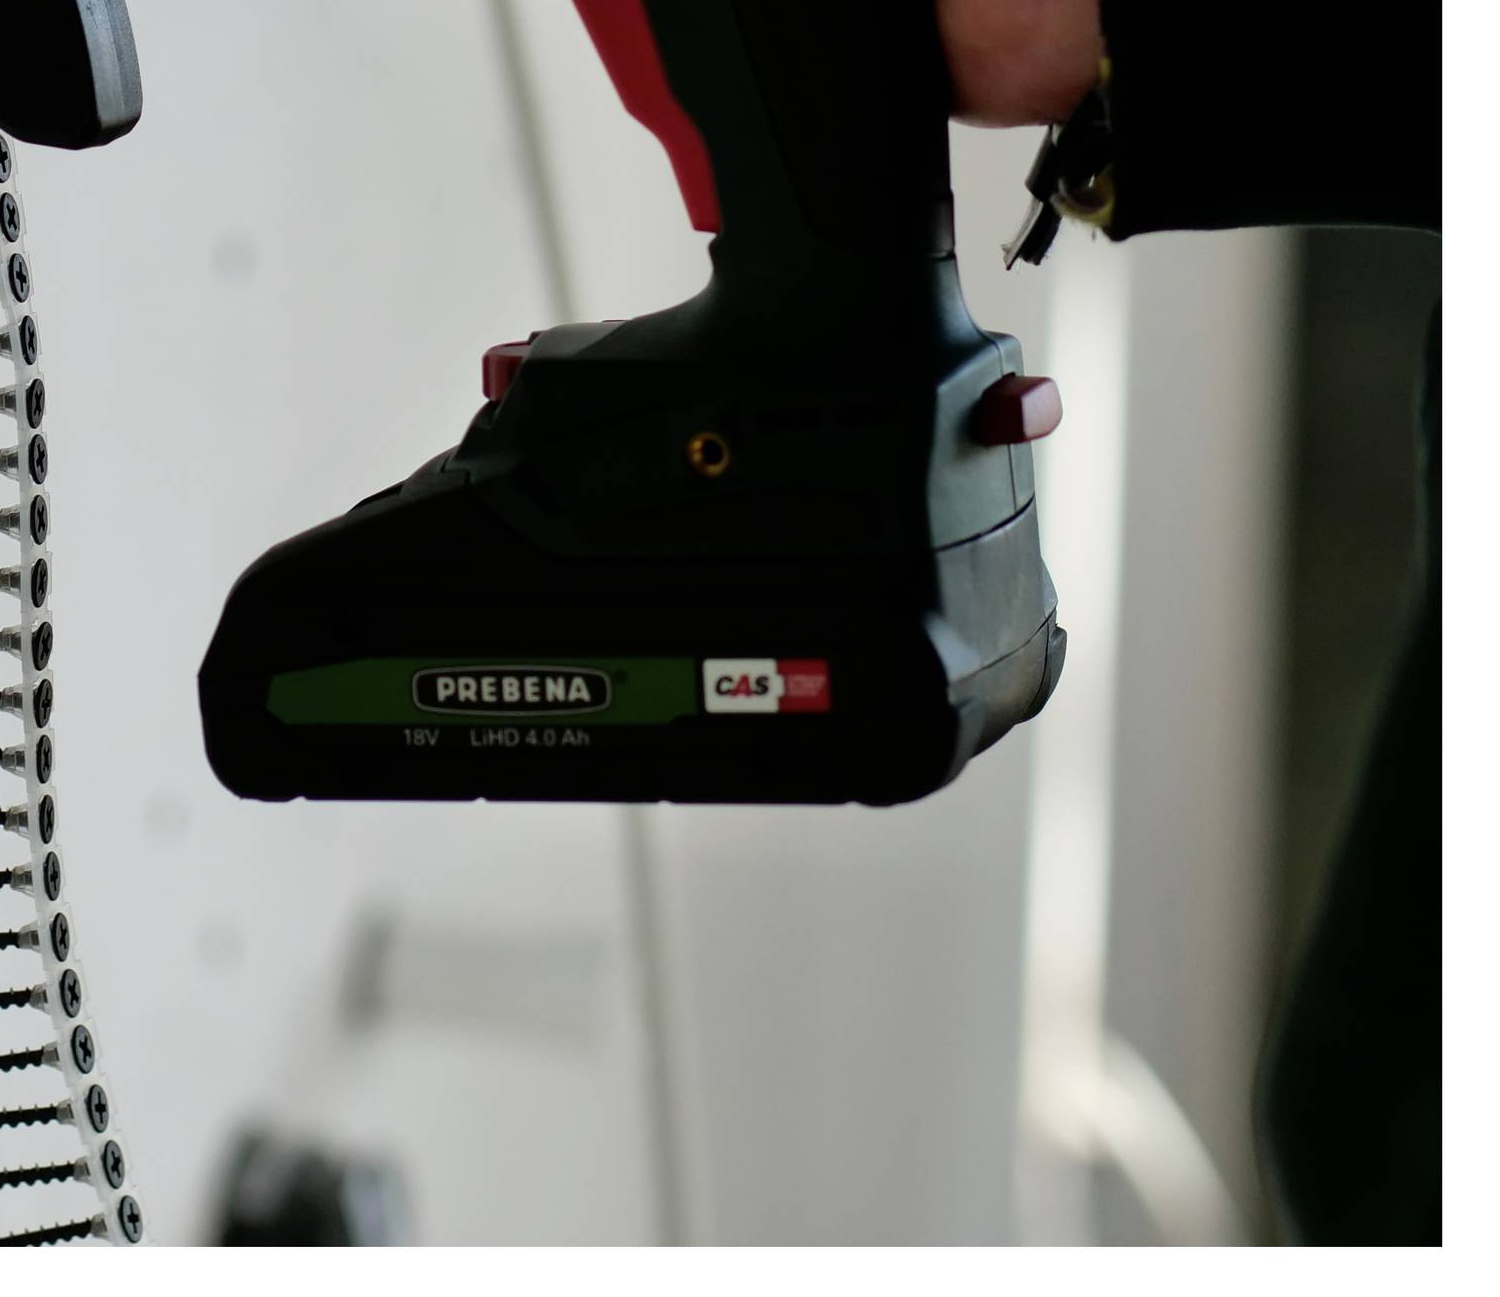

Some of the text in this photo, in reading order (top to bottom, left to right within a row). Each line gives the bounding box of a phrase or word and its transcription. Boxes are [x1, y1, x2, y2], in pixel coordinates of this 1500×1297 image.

[436, 675, 591, 703] PREBENA
[714, 673, 770, 698] CAS
[404, 728, 590, 747] 18V LiHD 4.0 Ah
